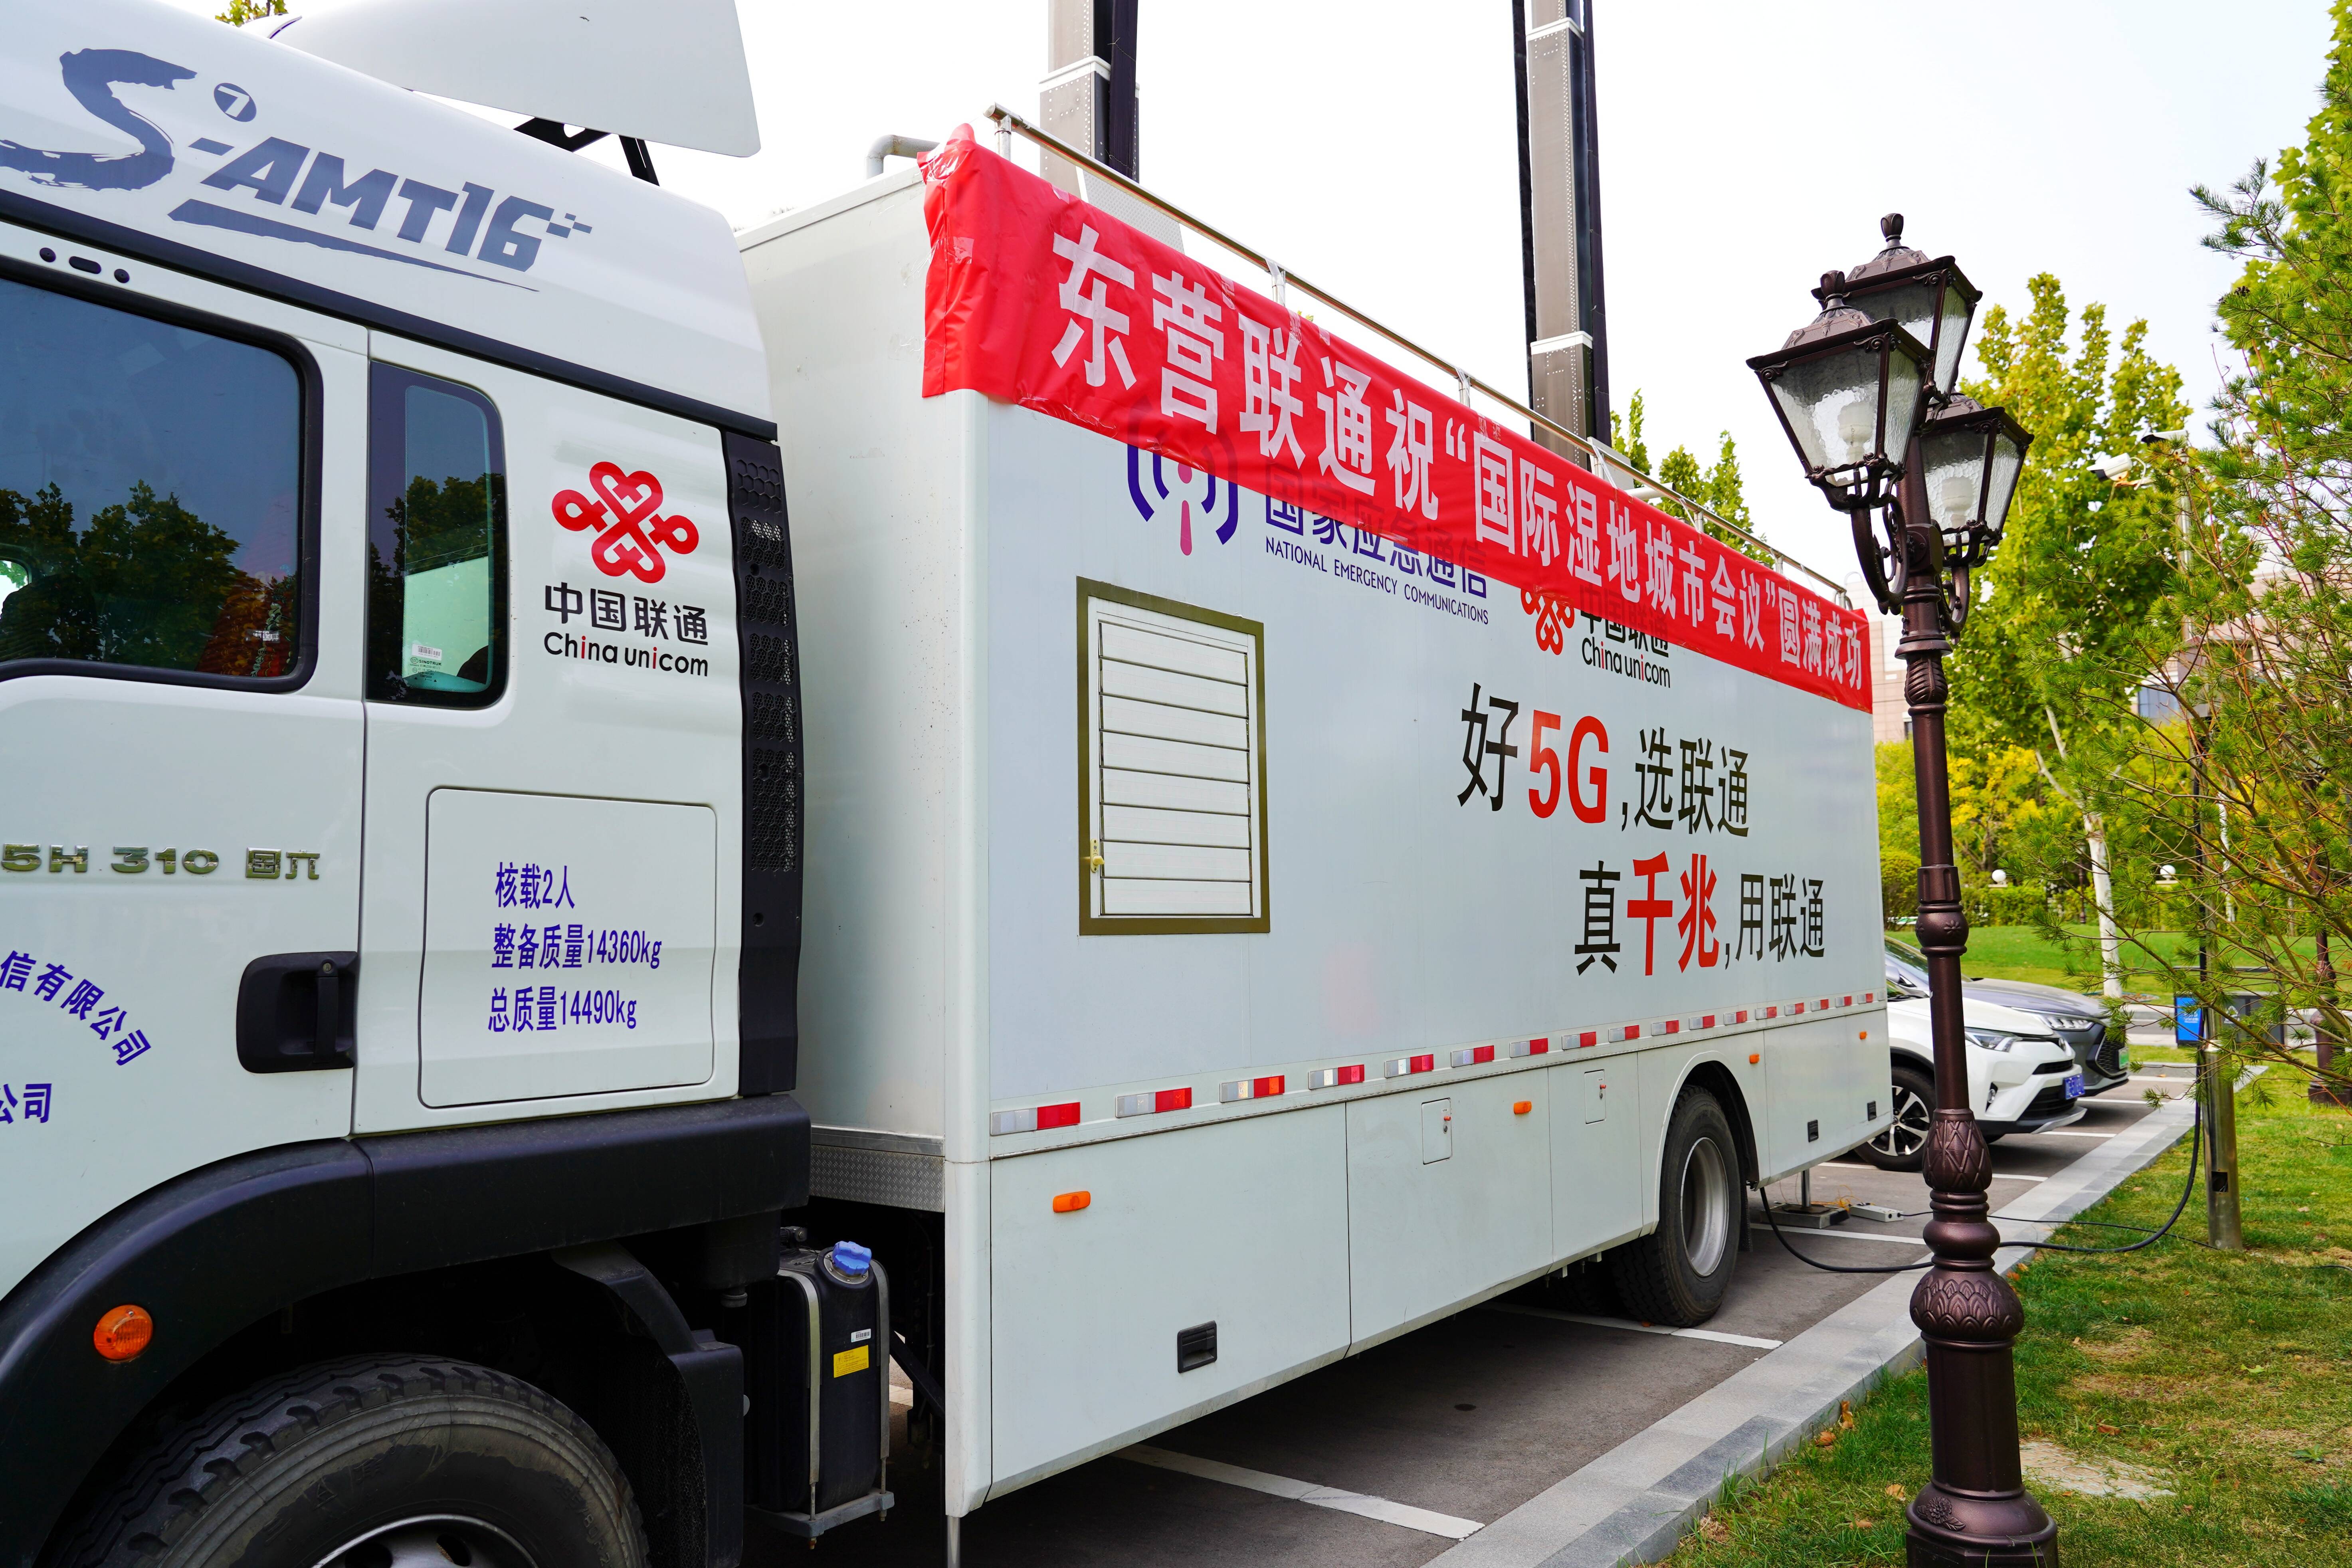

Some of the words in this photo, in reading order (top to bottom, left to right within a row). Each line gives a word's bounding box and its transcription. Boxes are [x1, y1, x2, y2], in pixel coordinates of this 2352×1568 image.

[1266, 535, 1327, 572] NATIONAL
[1334, 559, 1398, 595] EMERGENCY
[1404, 584, 1488, 625] COMMUNICATIONS
[545, 582, 709, 645] 中国联通
[544, 632, 618, 663] China
[625, 646, 708, 677] unicom
[1582, 636, 1622, 674] China
[1625, 654, 1670, 688] unicom
[1, 843, 89, 873] 5H
[111, 846, 220, 874] 310
[245, 847, 320, 880] 国六
[495, 861, 575, 909] 核载2人
[491, 923, 662, 970] 整备质量14360kg
[0, 950, 152, 1066] 信有限公司
[487, 986, 637, 1032] 总质量14490kg
